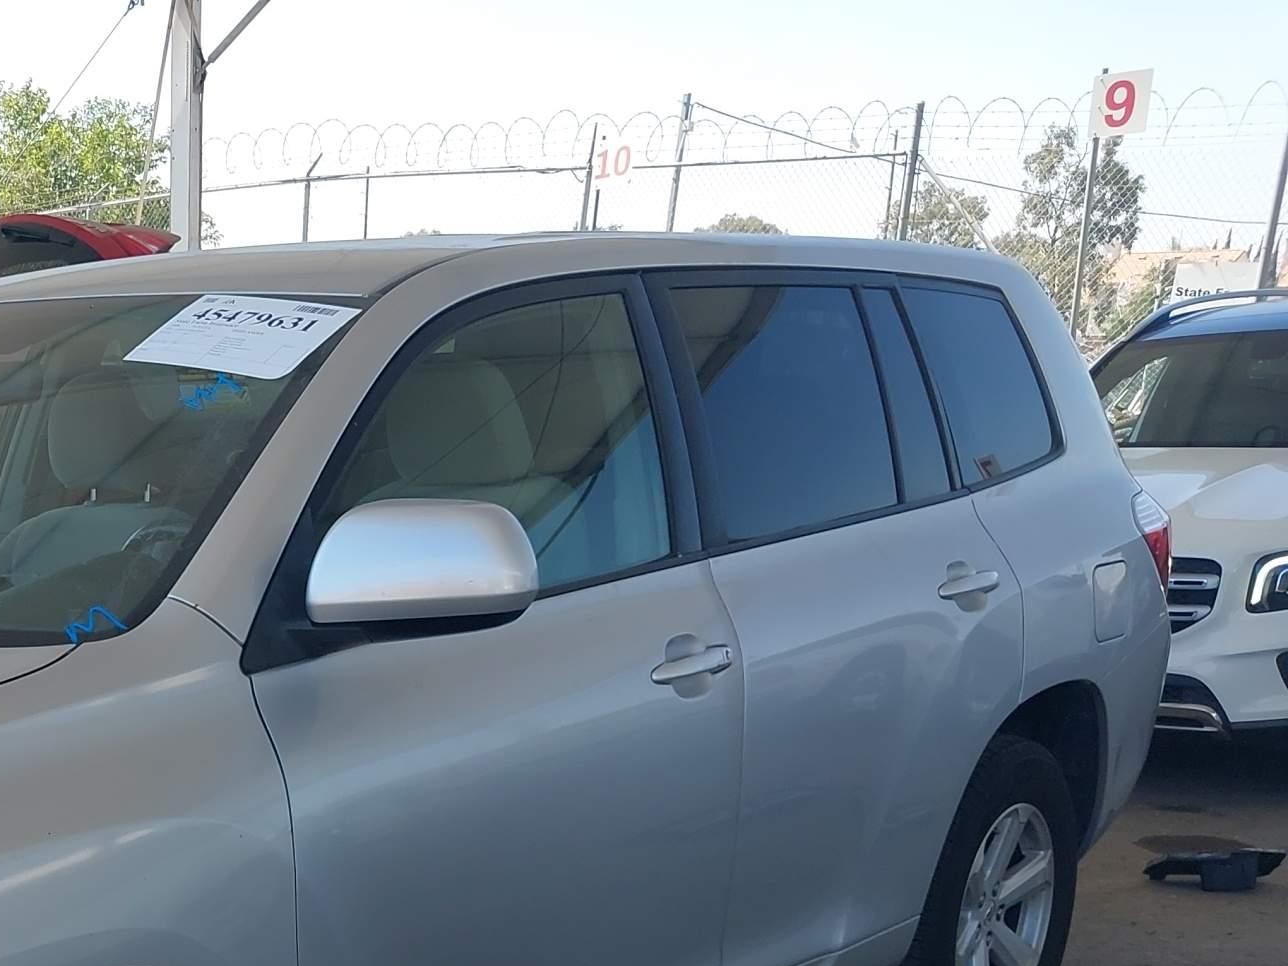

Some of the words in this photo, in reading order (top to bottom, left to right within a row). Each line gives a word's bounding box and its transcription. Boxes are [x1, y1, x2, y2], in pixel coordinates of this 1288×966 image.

[1104, 80, 1136, 128] 9
[594, 145, 631, 180] 10
[1175, 286, 1211, 297] State
[191, 308, 319, 332] 45479631
